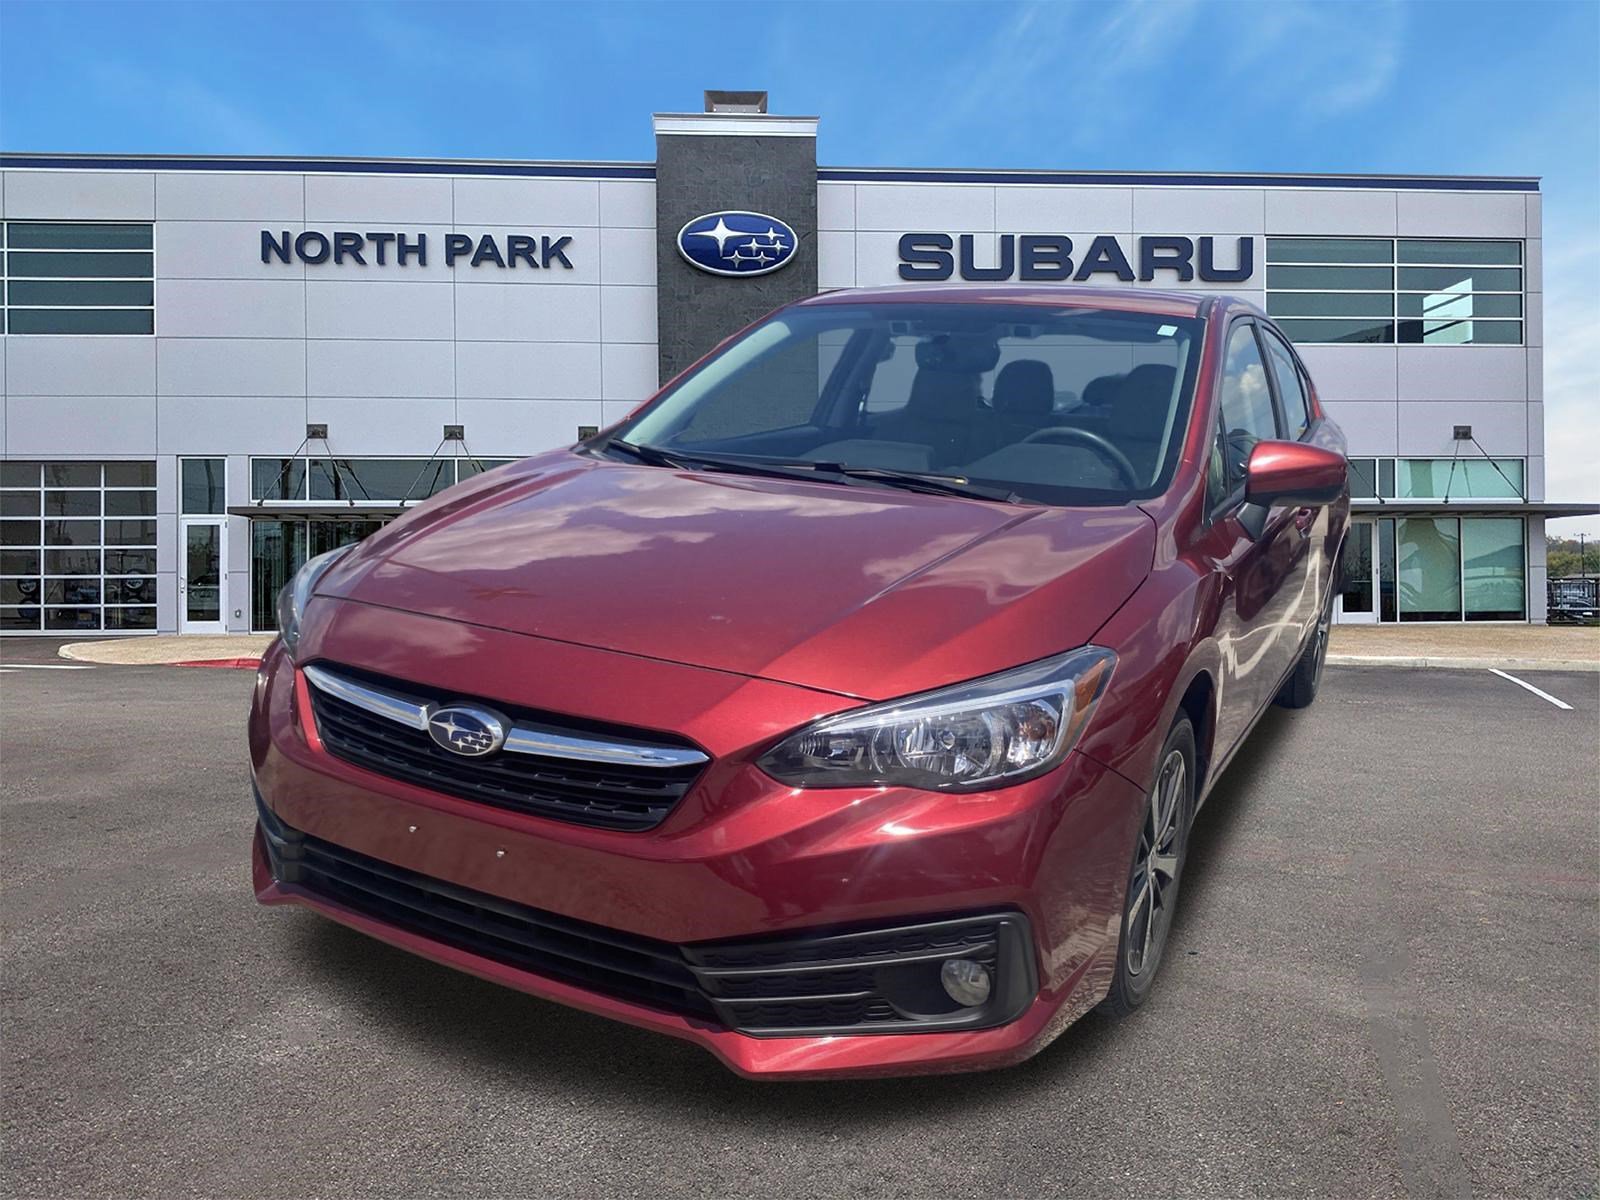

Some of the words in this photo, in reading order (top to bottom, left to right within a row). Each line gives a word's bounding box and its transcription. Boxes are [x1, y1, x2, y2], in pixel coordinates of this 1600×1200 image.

[262, 230, 427, 266] NORTH
[445, 234, 573, 269] PARK
[898, 233, 1254, 282] SUBARU
